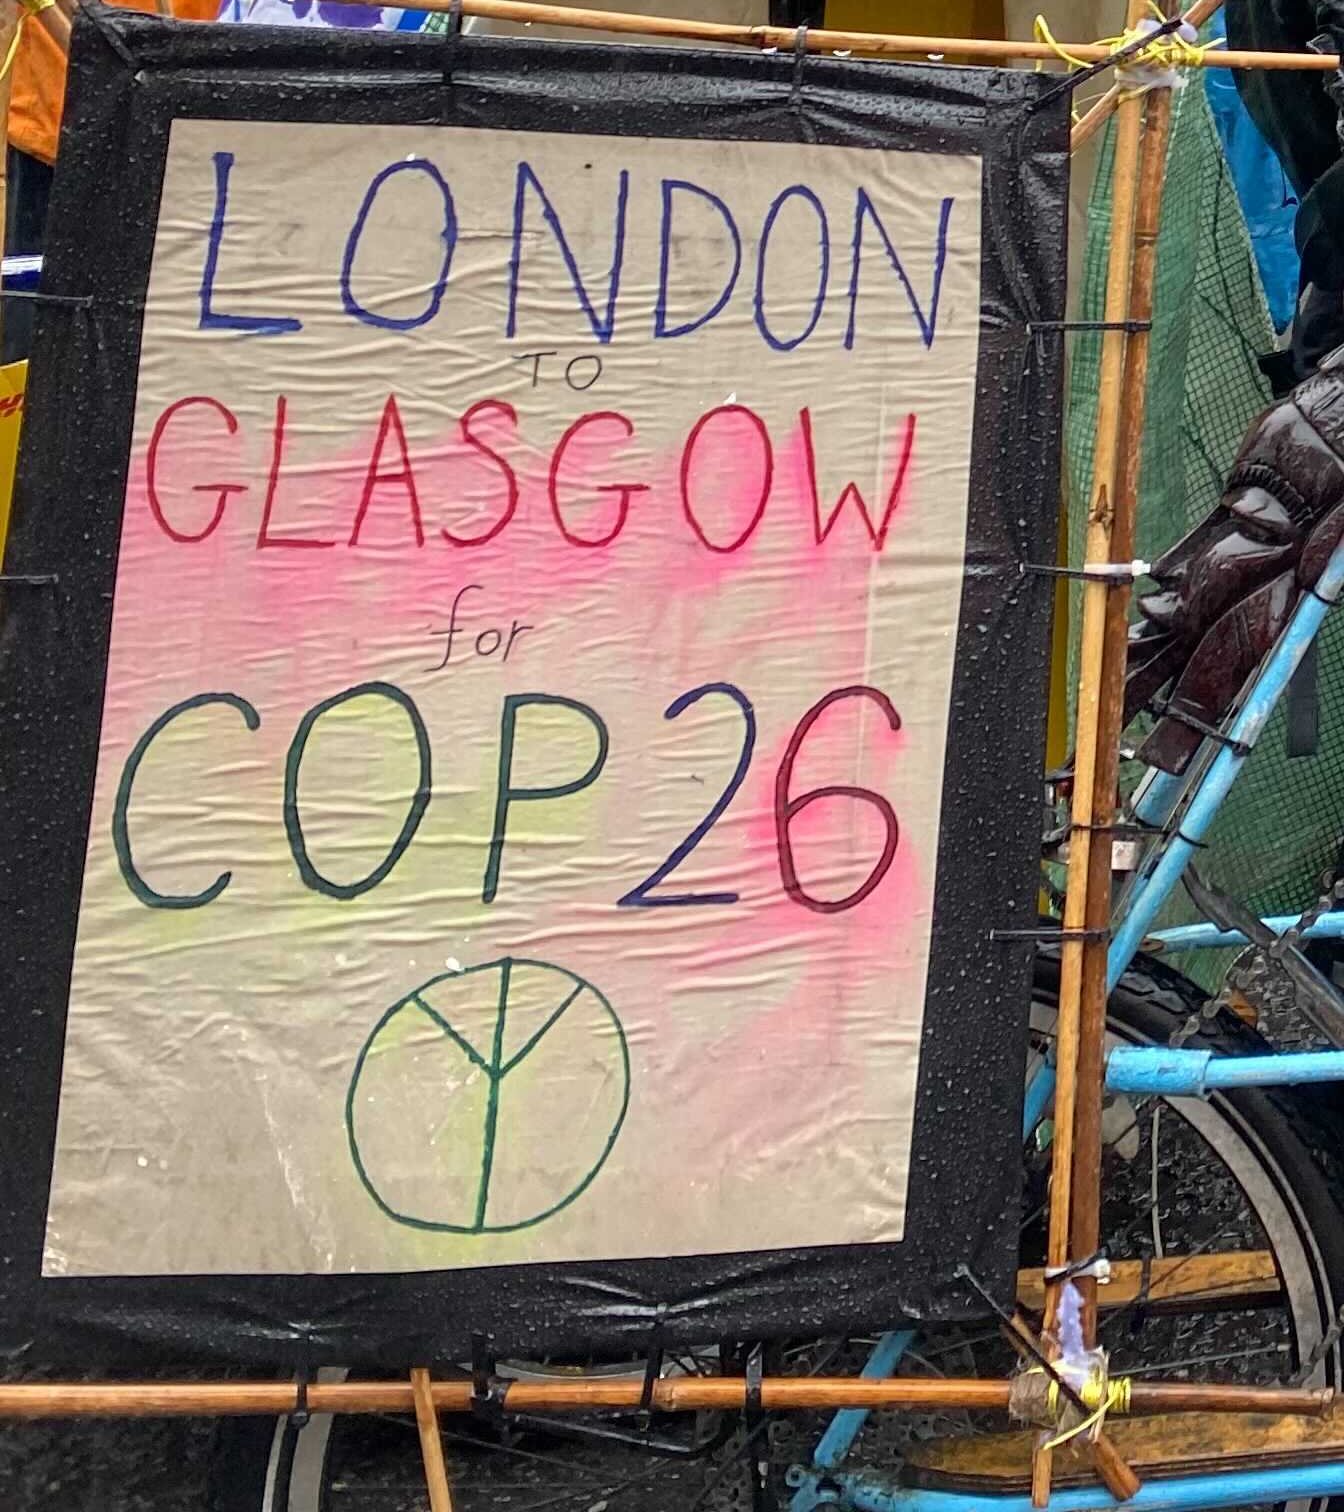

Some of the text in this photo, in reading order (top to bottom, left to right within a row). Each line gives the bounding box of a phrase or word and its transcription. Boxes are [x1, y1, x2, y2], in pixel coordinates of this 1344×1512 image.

[196, 152, 956, 350] LONDON
[515, 352, 604, 391] TO
[145, 396, 916, 551] GLASGOW
[428, 584, 534, 672] for
